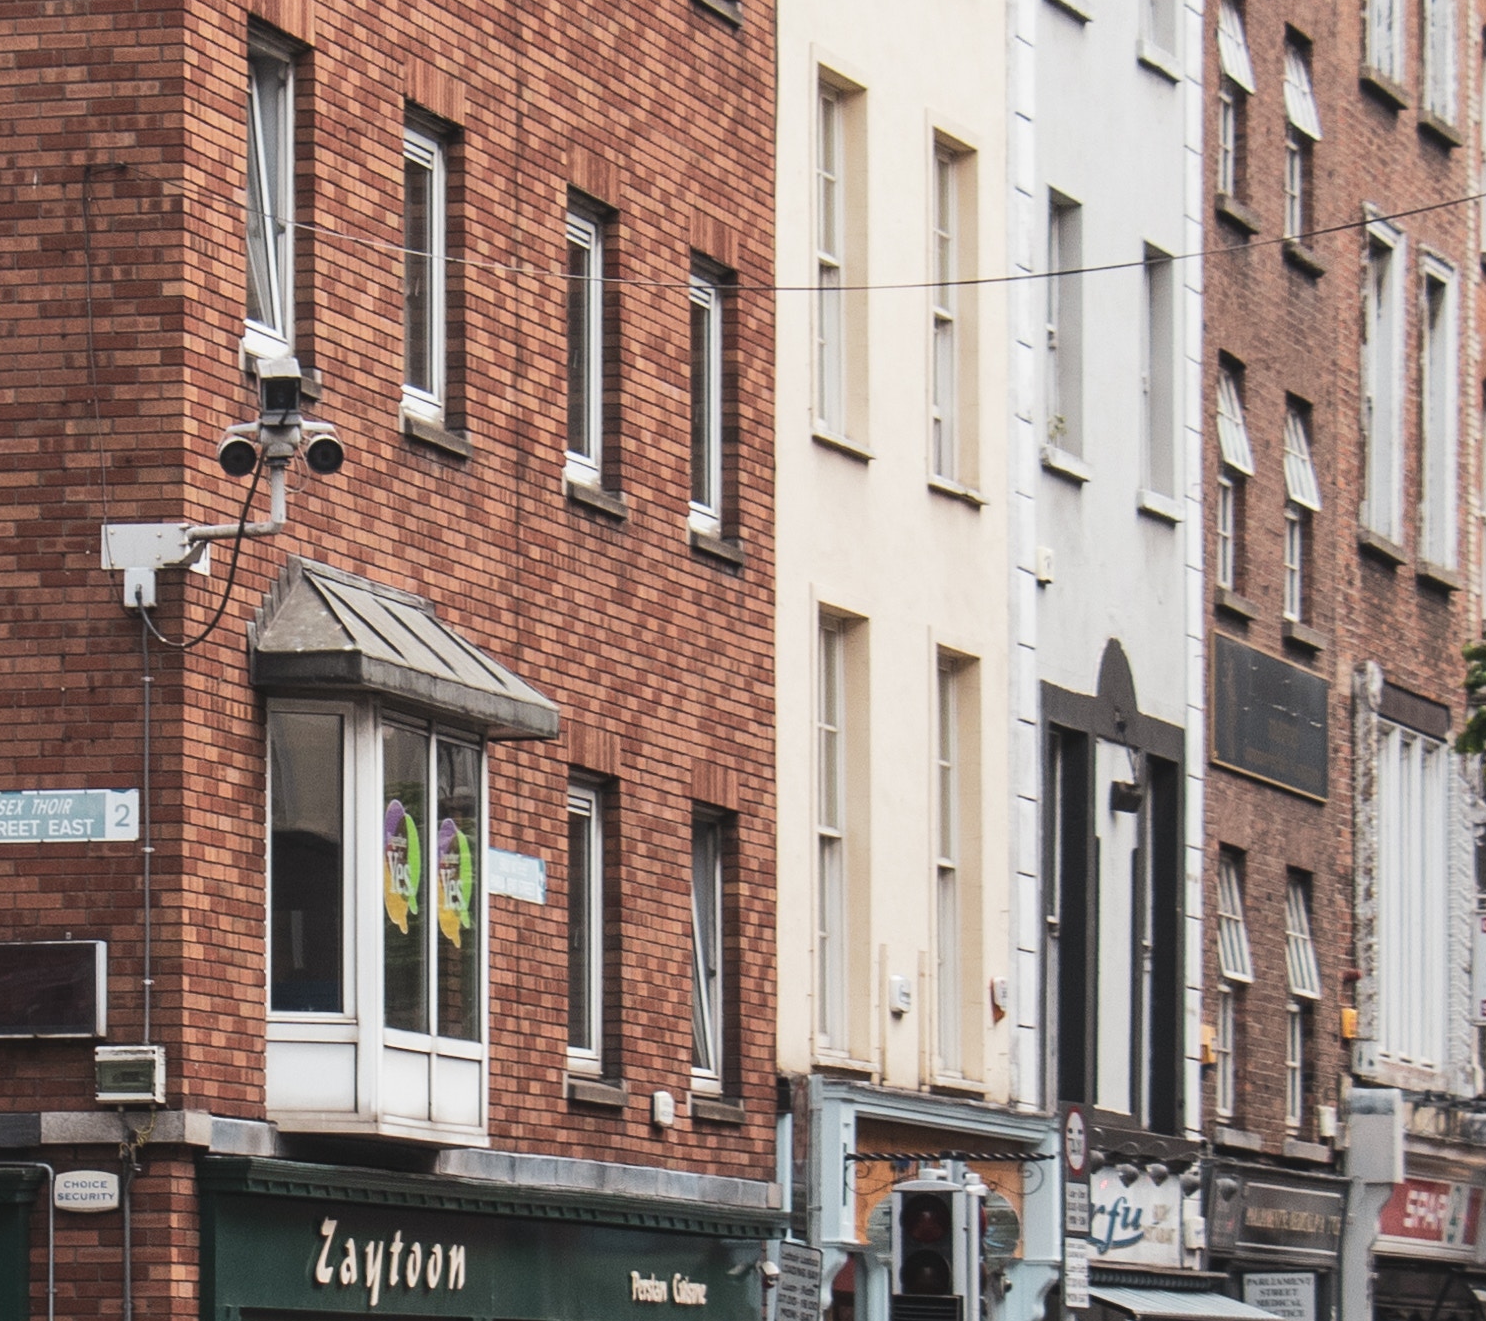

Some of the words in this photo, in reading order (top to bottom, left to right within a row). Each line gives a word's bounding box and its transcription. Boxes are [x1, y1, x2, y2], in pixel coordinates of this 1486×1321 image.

[31, 797, 74, 816] THOIR
[114, 804, 130, 828] 2
[48, 819, 94, 837] EAST
[63, 1180, 108, 1189] CHOICE
[57, 1192, 115, 1201] SECURITY
[1403, 1189, 1450, 1229] SPAR
[314, 1216, 466, 1307] Zaytoon
[629, 1269, 668, 1303] Persian
[671, 1272, 708, 1306] Cuisine
